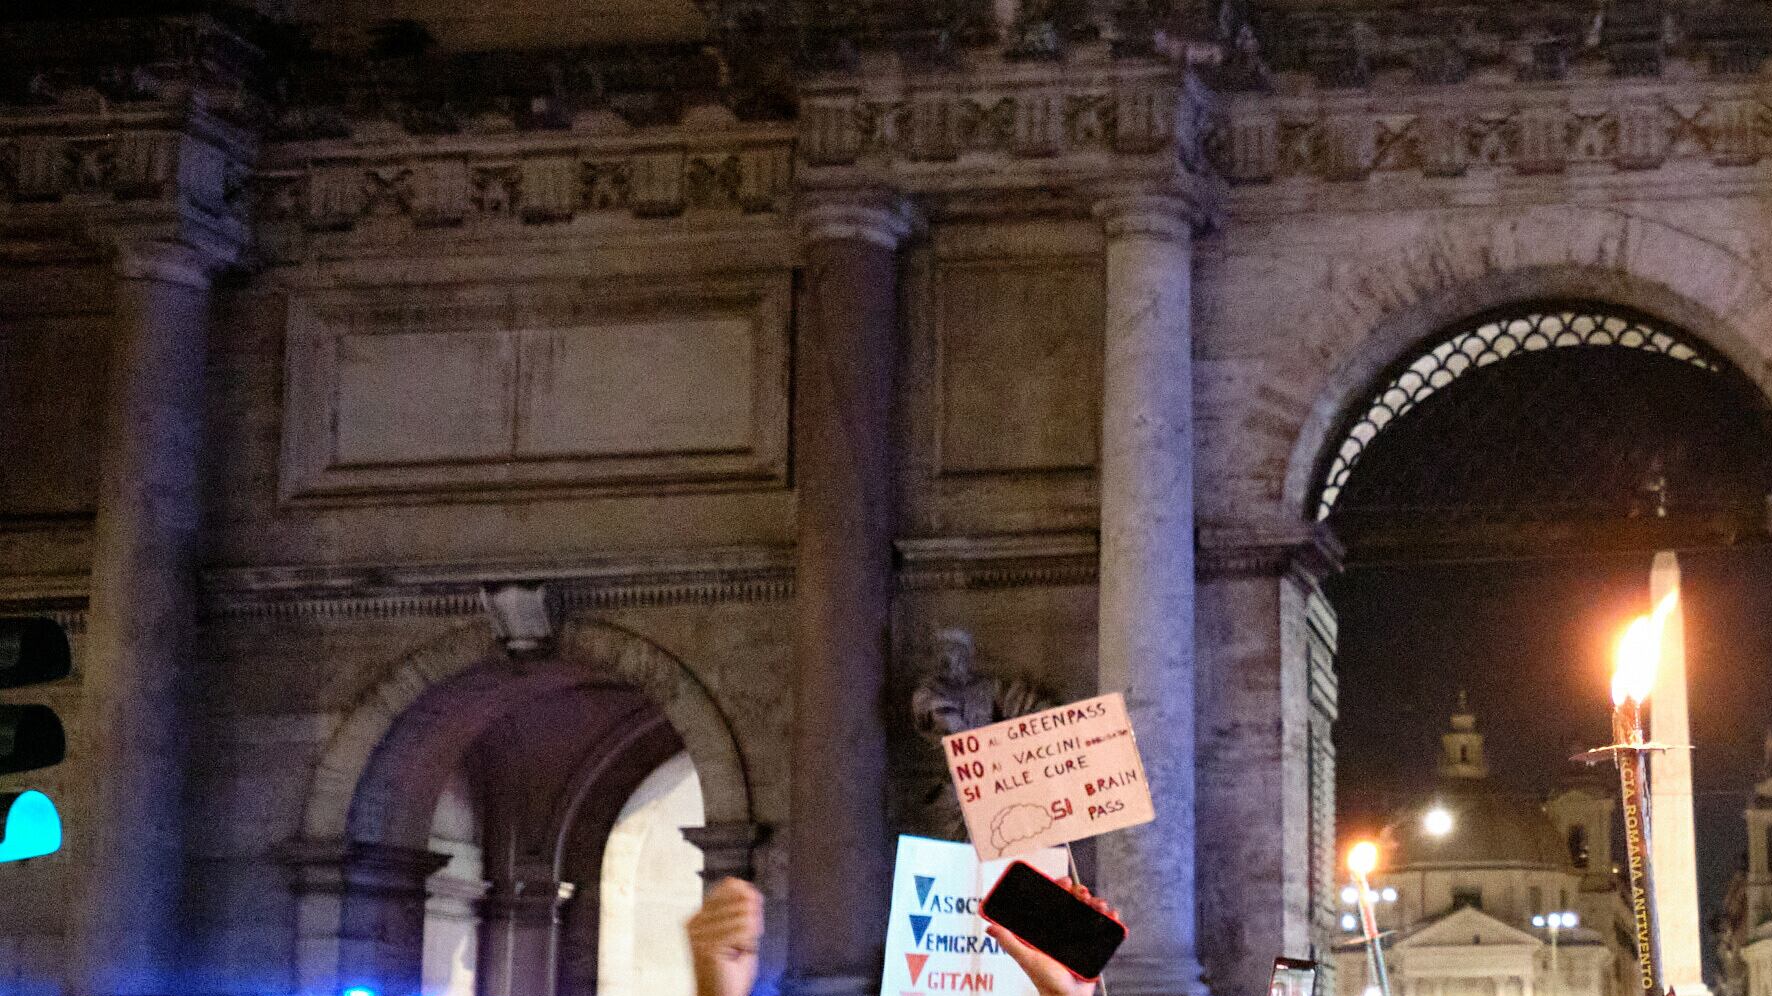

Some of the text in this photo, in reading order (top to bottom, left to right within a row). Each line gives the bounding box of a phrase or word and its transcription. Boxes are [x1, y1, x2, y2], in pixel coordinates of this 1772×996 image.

[950, 735, 980, 757] NO
[956, 761, 985, 782] NO
[1013, 736, 1082, 764] VACCINI
[963, 755, 1090, 804] SI ALLE CURE
[1084, 769, 1138, 797] BRAIN
[1051, 798, 1073, 820] SI
[1088, 800, 1125, 821] PASS
[1625, 804, 1643, 882] ROMANA
[930, 896, 982, 914] ASOC
[1632, 886, 1654, 990] ANTIVENTO
[927, 972, 995, 993] GITANI
